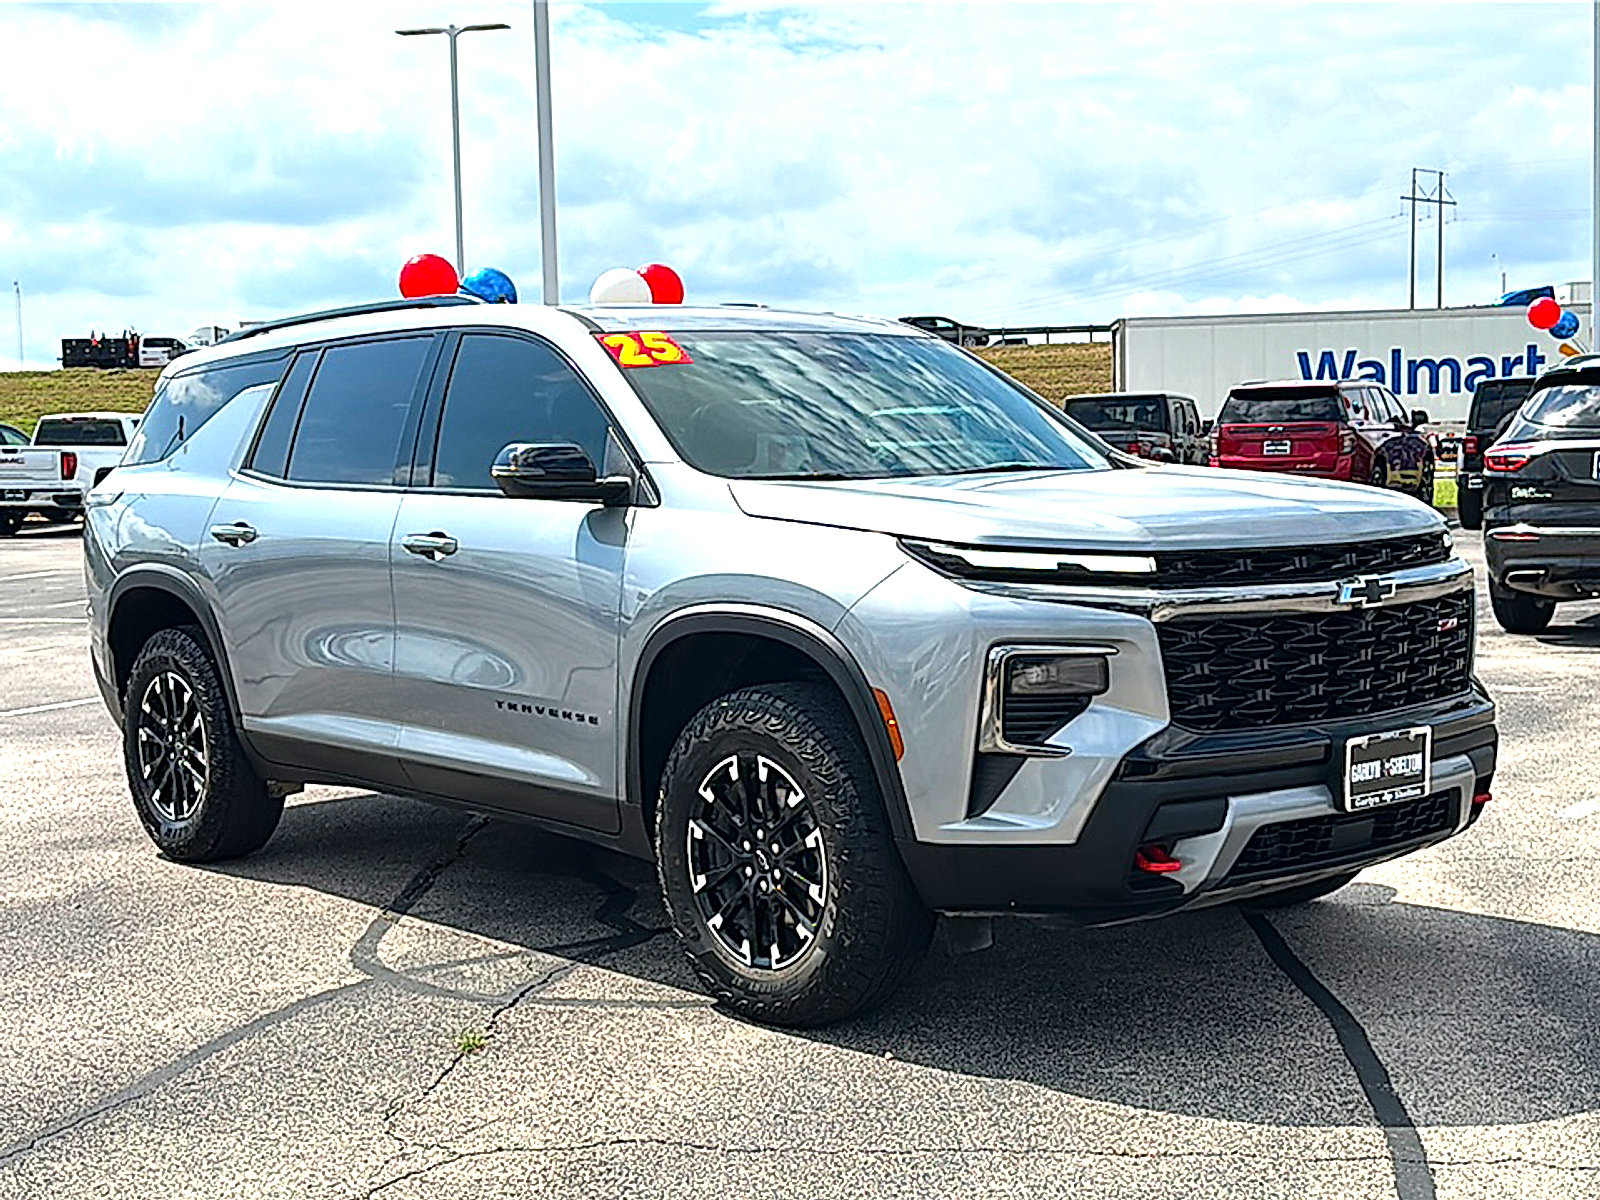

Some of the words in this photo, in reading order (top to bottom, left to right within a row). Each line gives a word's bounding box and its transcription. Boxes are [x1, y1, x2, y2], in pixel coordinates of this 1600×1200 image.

[603, 332, 682, 365] 25
[1296, 344, 1546, 396] Walmart
[495, 699, 599, 726] TRAVERSE
